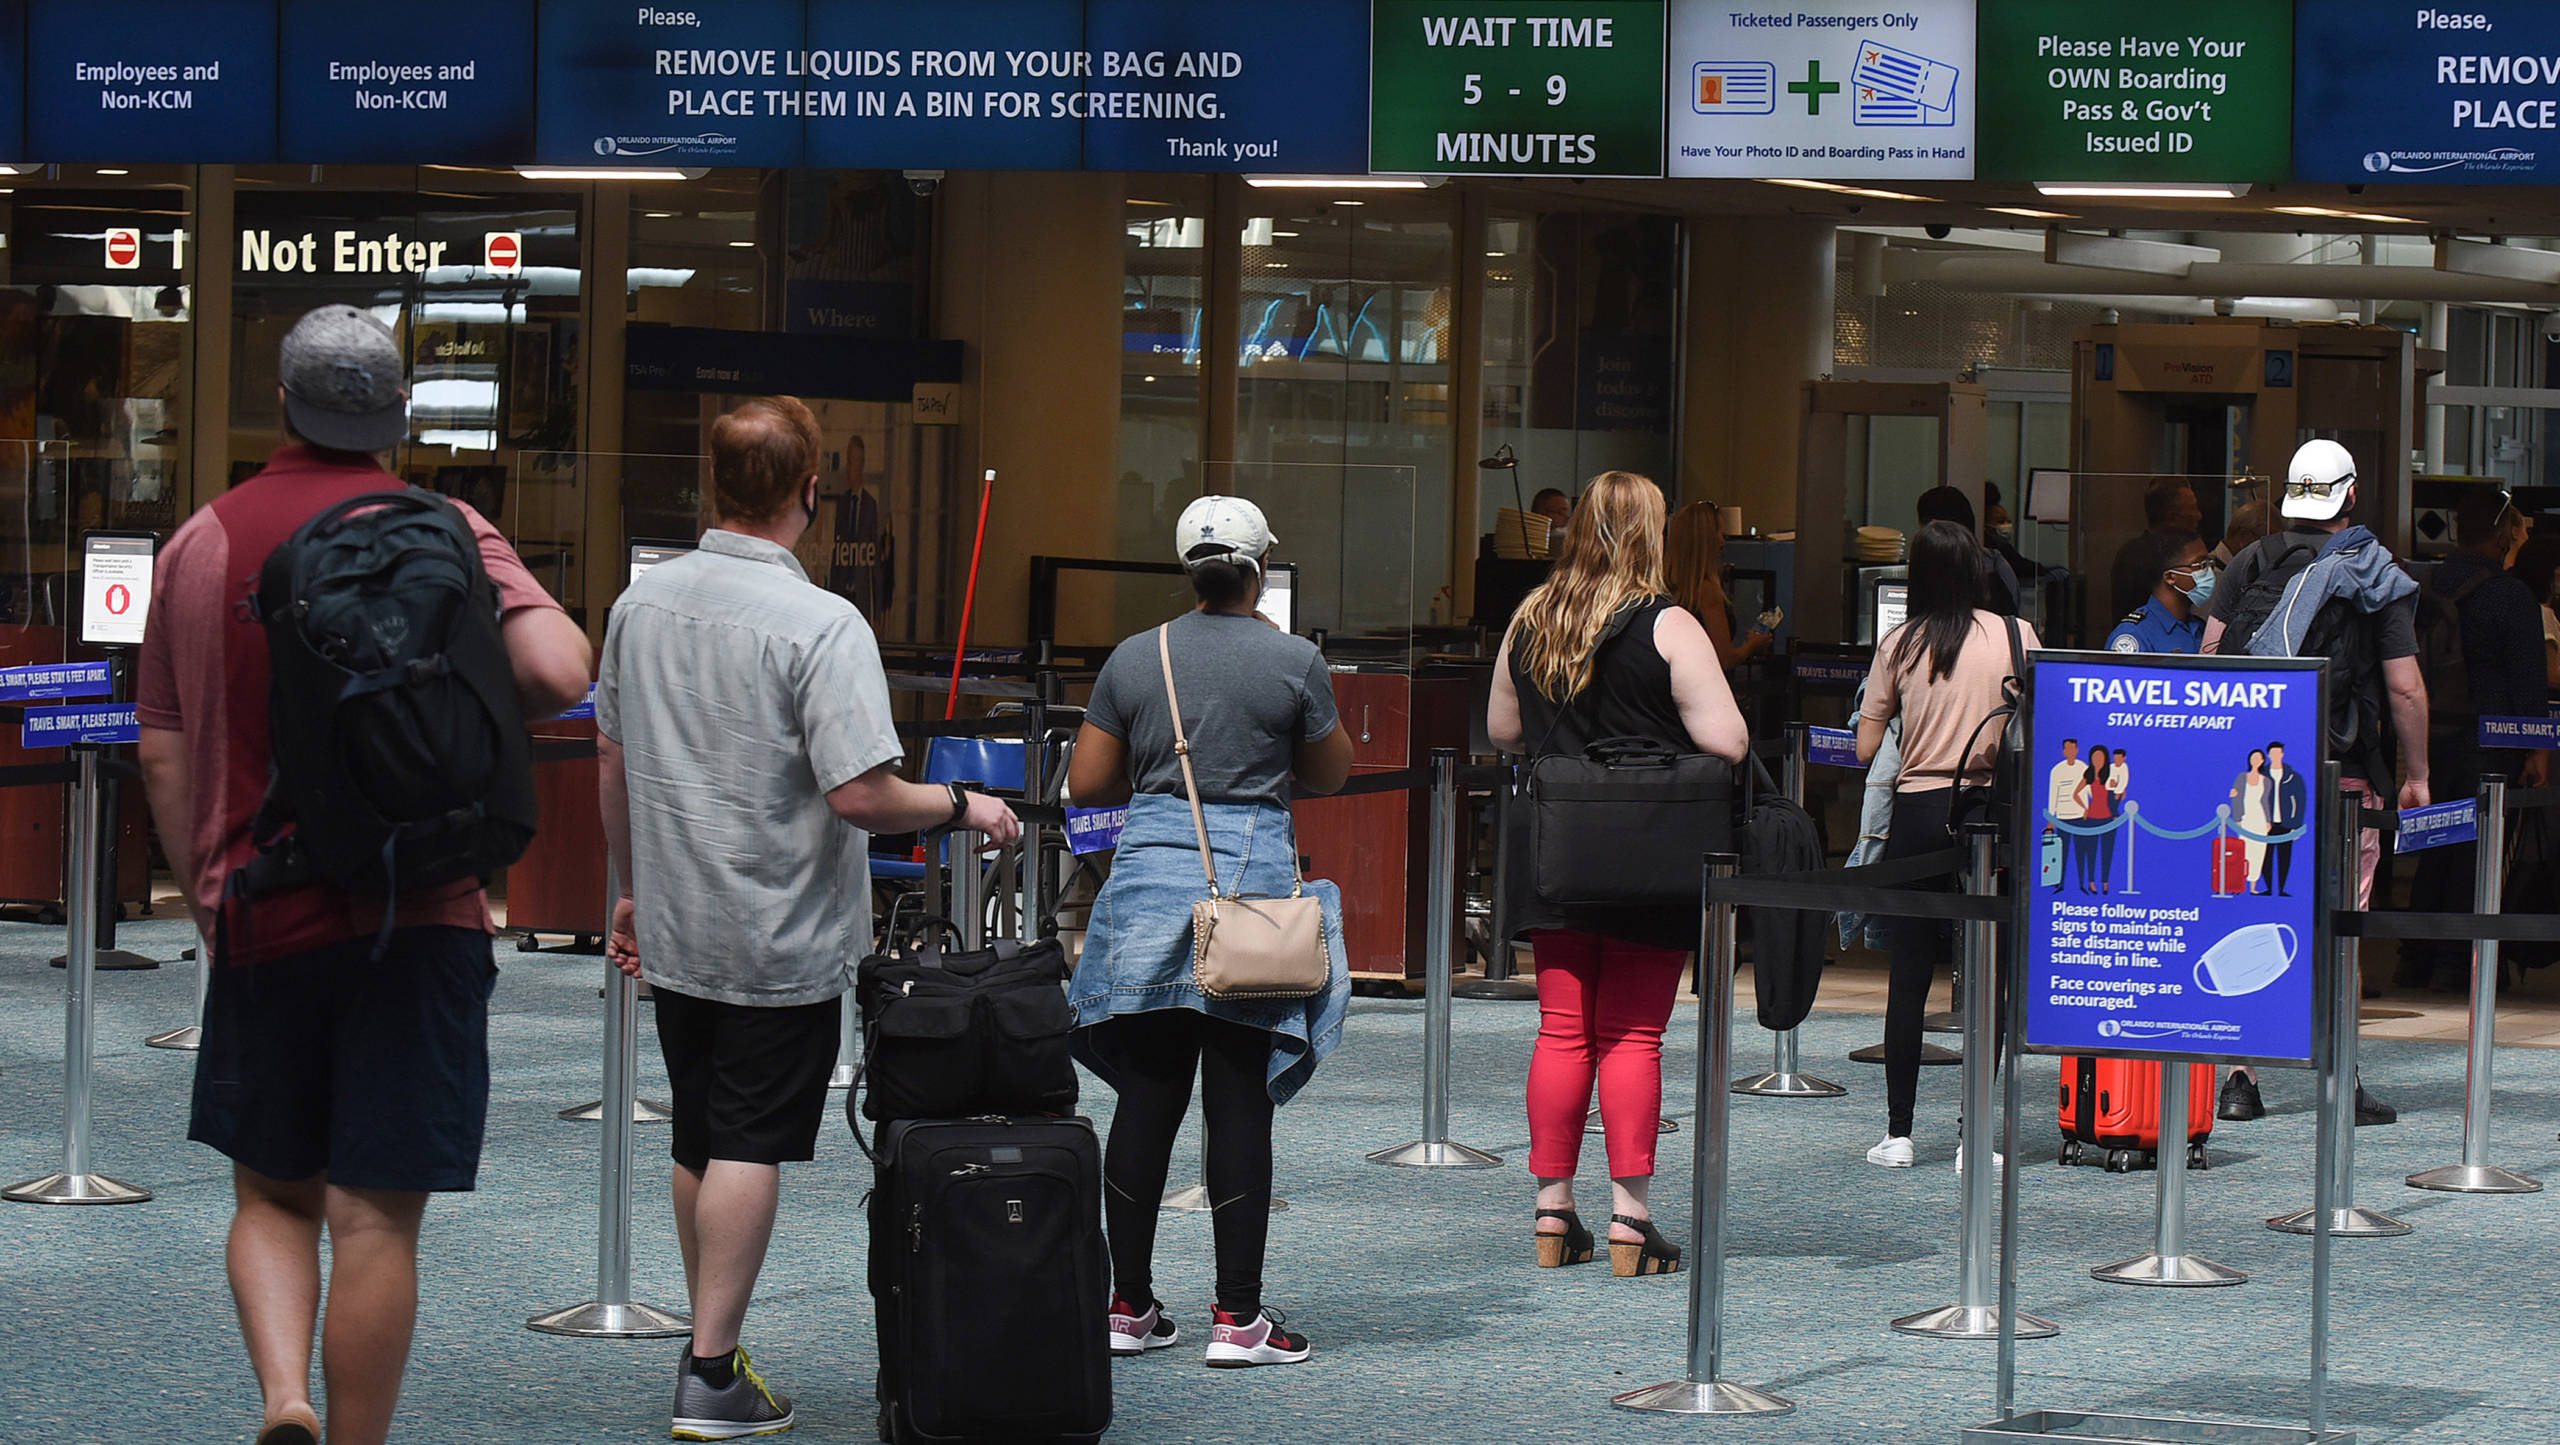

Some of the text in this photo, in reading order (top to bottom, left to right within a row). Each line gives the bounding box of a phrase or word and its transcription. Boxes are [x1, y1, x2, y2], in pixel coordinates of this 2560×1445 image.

[639, 7, 700, 27] Please,
[1729, 12, 1918, 31] Ticketed Passengers Only
[2417, 9, 2492, 31] Please,
[1422, 17, 1612, 47] WAIT TIME
[2039, 35, 2245, 57] Please Have Your
[76, 61, 219, 85] Employees and
[330, 60, 474, 85] Employees and
[656, 49, 1241, 80] REMOVE LIQUIDS FROM YOUR BAG AND
[2438, 56, 2560, 84] REMOV
[1464, 74, 1481, 104] 5
[1546, 75, 1566, 105] 9
[2048, 67, 2226, 95] OWN Boarding
[102, 90, 191, 108] Non-KCM
[356, 90, 446, 109] Non-KCM
[669, 90, 1225, 119] PLACE THEM IN A BIN FOR SCREENING.
[2064, 100, 2113, 120] Pass
[2121, 100, 2138, 120] &
[2453, 100, 2556, 128] PLACE
[617, 136, 736, 145] ORLANDO INTERNATIONAL AIRPORT
[1167, 137, 1277, 161] Thank you!
[1437, 133, 1595, 163] MINUTES
[2087, 131, 2192, 152] Issued ID
[1681, 145, 1965, 161] Have Your Photo ID and Boarding Pass in Hand
[2391, 152, 2535, 161] ORLANDO INTERNATIONAL AIRPORT
[242, 231, 448, 272] Not Enter
[808, 307, 876, 328] Where
[2164, 362, 2214, 373] ProVision
[2271, 357, 2285, 382] 2
[2190, 374, 2214, 384] ATD
[28, 671, 50, 685] PLEASE
[51, 671, 66, 684] STAY
[71, 670, 86, 683] FEET
[1797, 667, 1827, 678] TRAVEL
[2068, 677, 2287, 709] TRAVEL SMART
[30, 717, 54, 732] TRAVEL
[56, 714, 80, 731] SMART,
[82, 713, 106, 728] PLEASE
[108, 711, 124, 726] STAY
[2107, 712, 2236, 730] STAY 6 FEET APART
[2485, 722, 2520, 735] TRAVEL
[2521, 723, 2555, 739] SMART,
[1070, 815, 1092, 835] TRAVEL
[2052, 901, 2199, 921] Please follow posted
[2052, 918, 2183, 936] signs to maintain a
[2051, 934, 2186, 953] safe distance while
[2051, 951, 2161, 968] standing in line.
[2051, 975, 2182, 995] Face coverings are
[2050, 994, 2137, 1011] encouraged.
[2120, 1019, 2240, 1032] ORLANDO INTERNATIONAL AIRPORT
